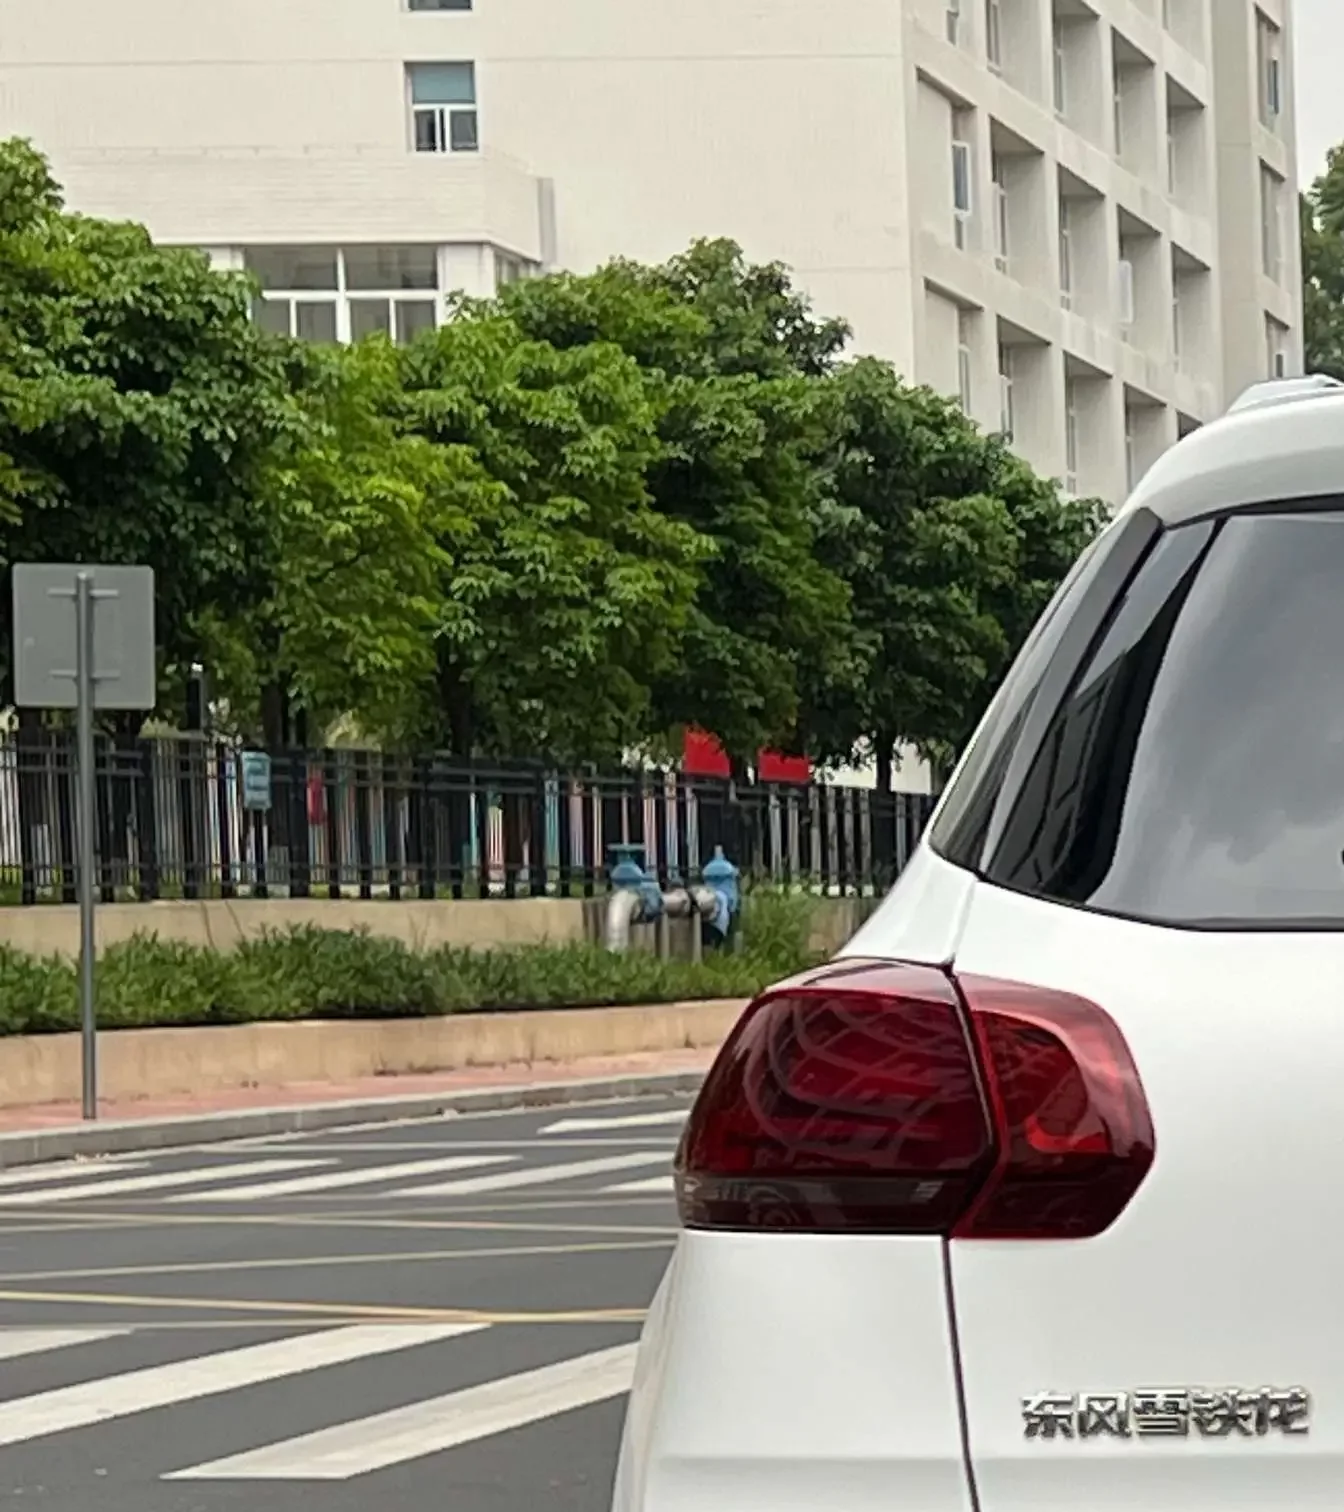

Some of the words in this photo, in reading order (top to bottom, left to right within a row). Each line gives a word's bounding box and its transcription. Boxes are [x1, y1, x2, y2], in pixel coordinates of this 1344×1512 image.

[1021, 1385, 1310, 1438] 东风雪铁龙
